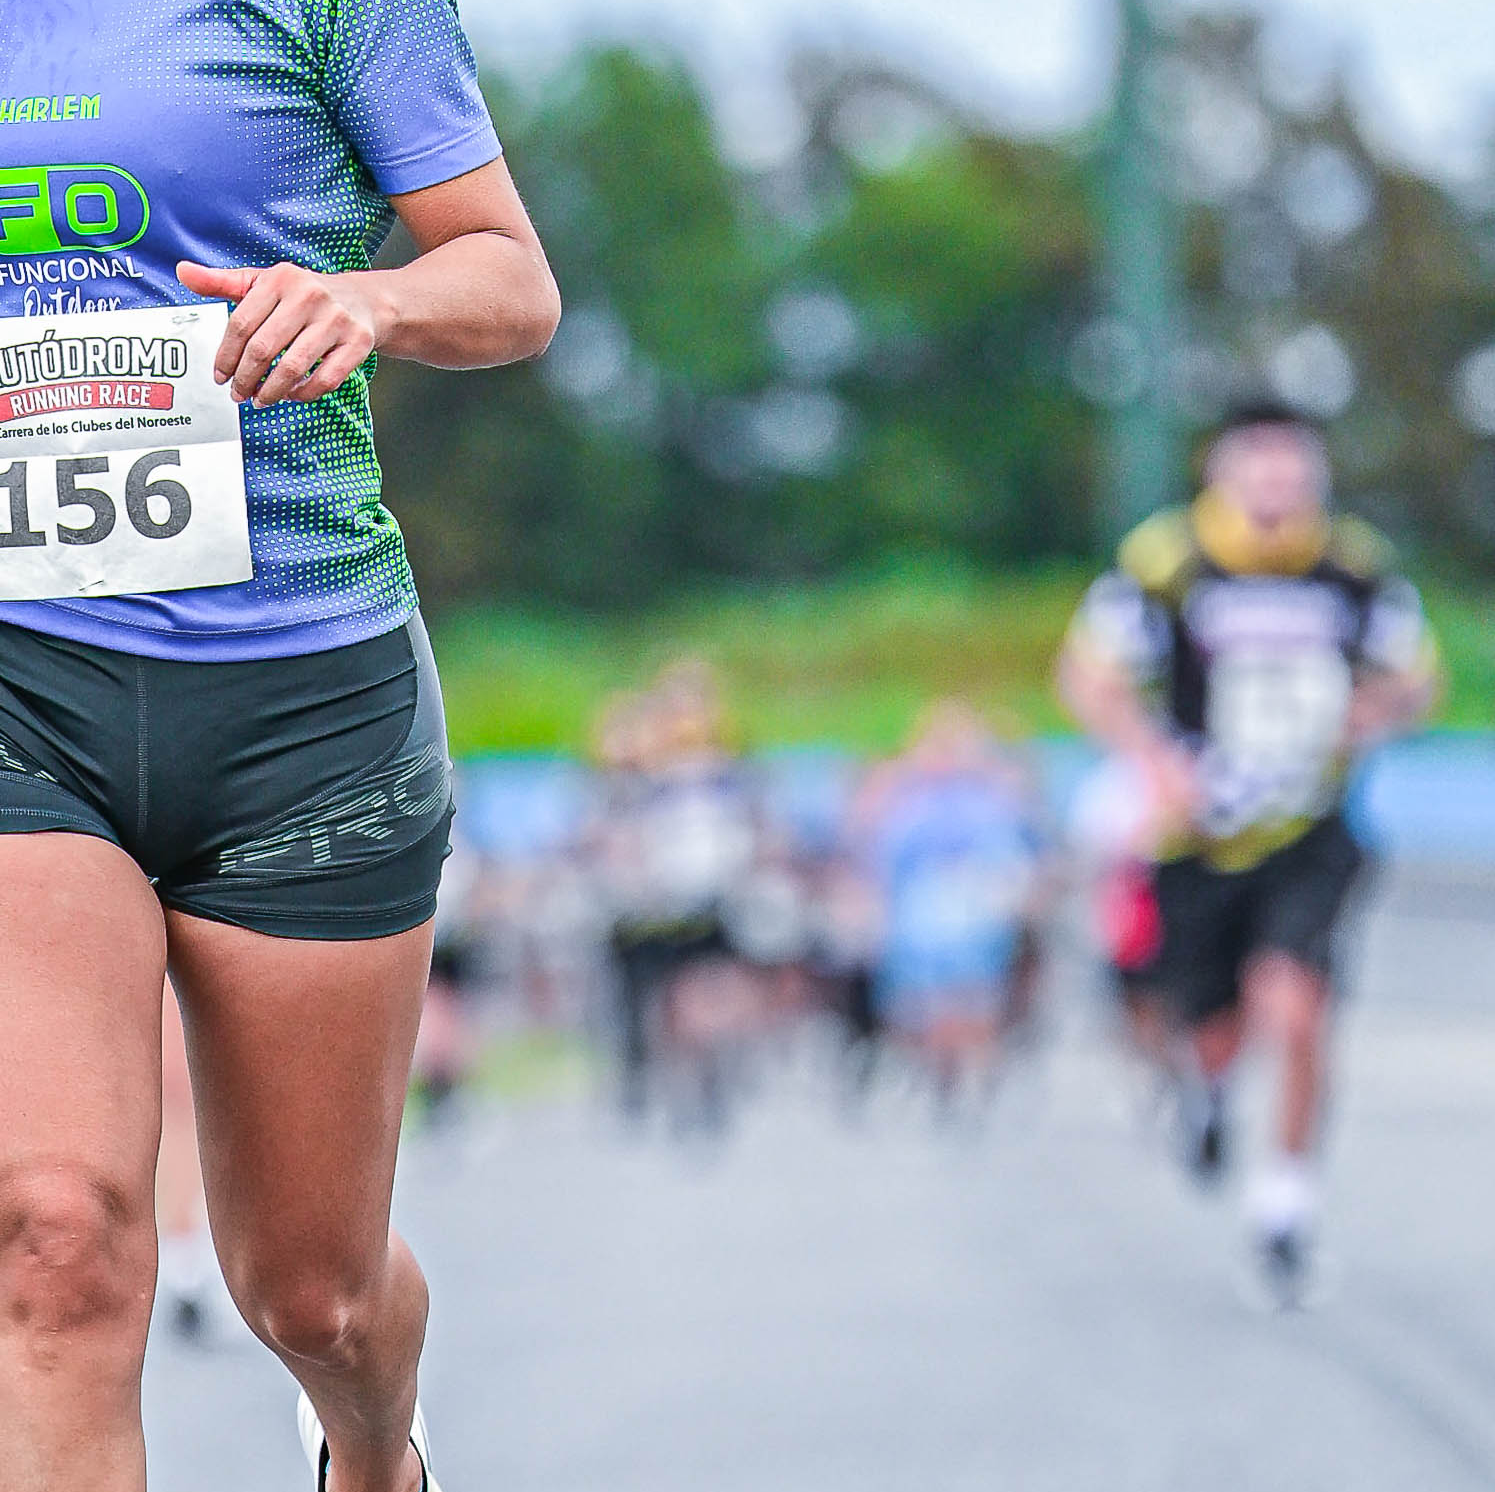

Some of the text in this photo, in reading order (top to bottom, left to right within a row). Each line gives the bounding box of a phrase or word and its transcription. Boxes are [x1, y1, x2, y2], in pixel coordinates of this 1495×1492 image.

[9, 383, 152, 417] RUNNING RACE
[36, 423, 50, 436] de
[52, 422, 68, 434] los
[71, 419, 112, 433] Clubes
[115, 417, 135, 430] del
[137, 415, 192, 429] Noroeste
